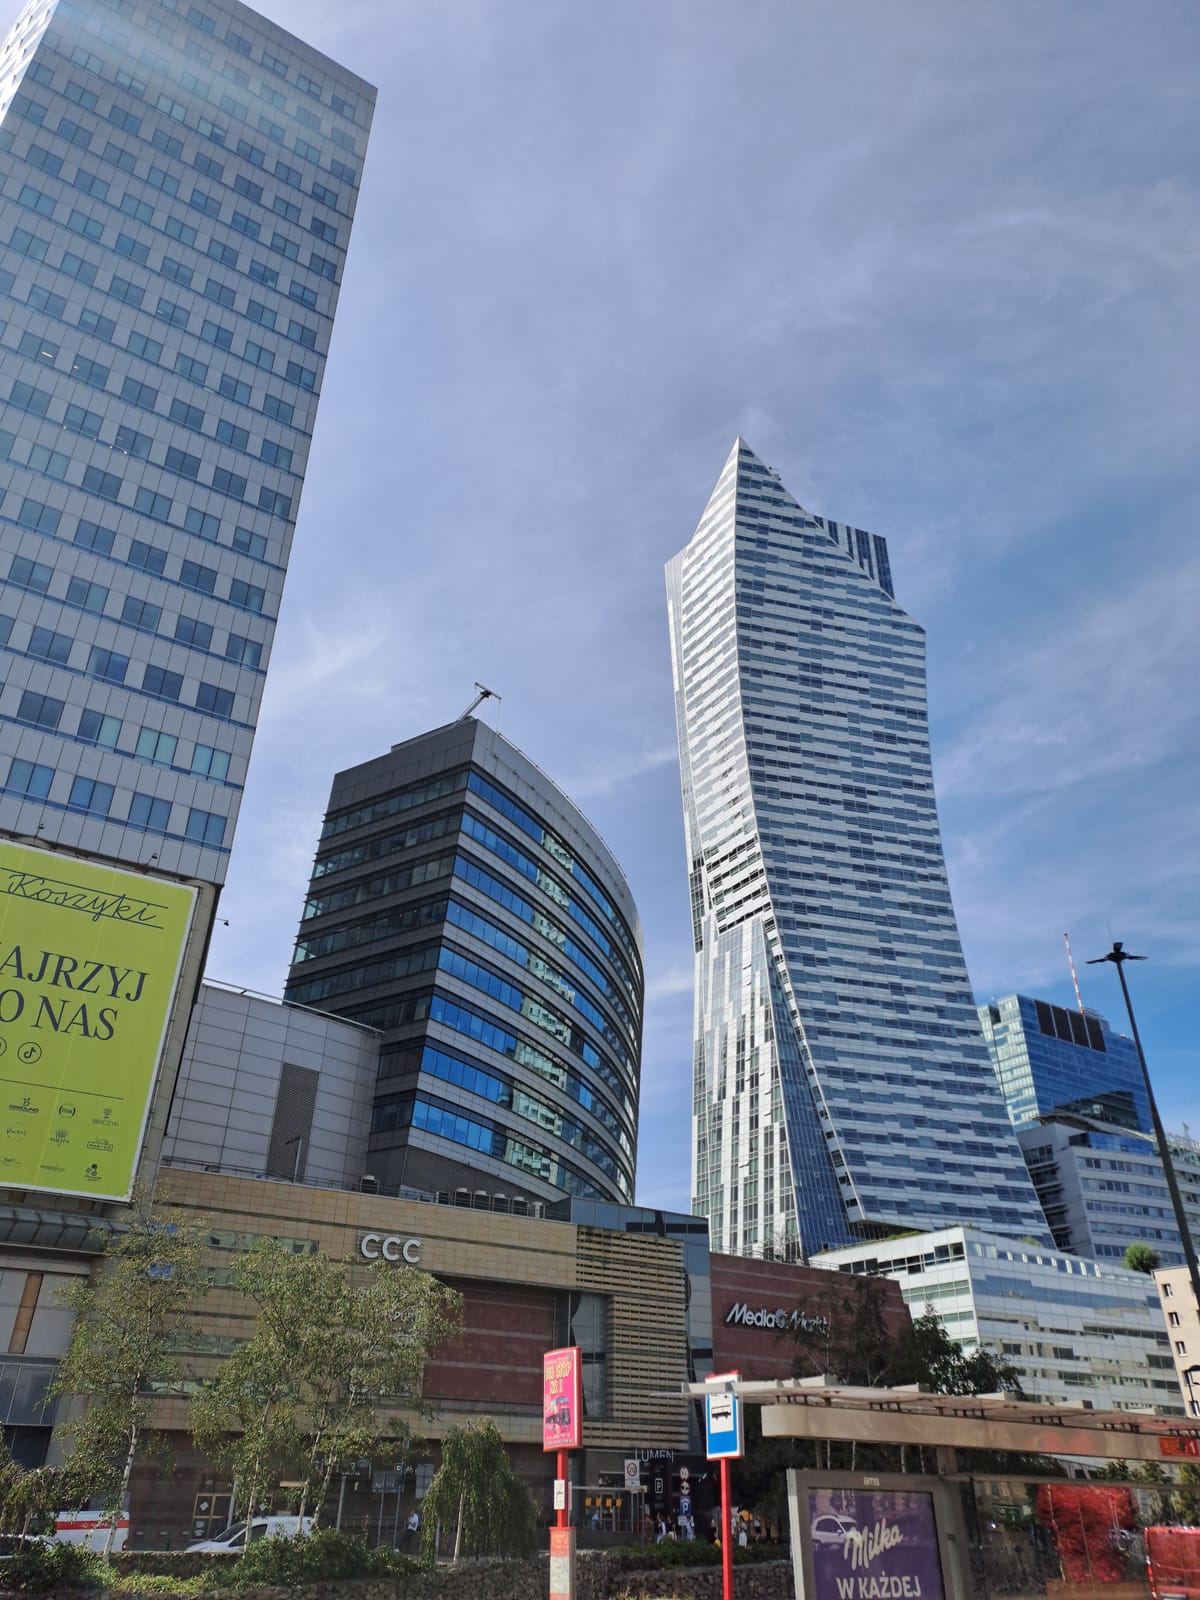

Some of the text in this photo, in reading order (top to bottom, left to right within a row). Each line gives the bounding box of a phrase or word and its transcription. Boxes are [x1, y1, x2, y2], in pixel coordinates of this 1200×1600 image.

[8, 873, 157, 922] Koszyki
[0, 942, 150, 1002] AJRZYJ
[30, 995, 119, 1041] NAS
[361, 1234, 421, 1263] CCC
[726, 1303, 775, 1328] Media
[843, 1518, 904, 1571] Milka
[836, 1571, 922, 1600] W KAŻDEJ
